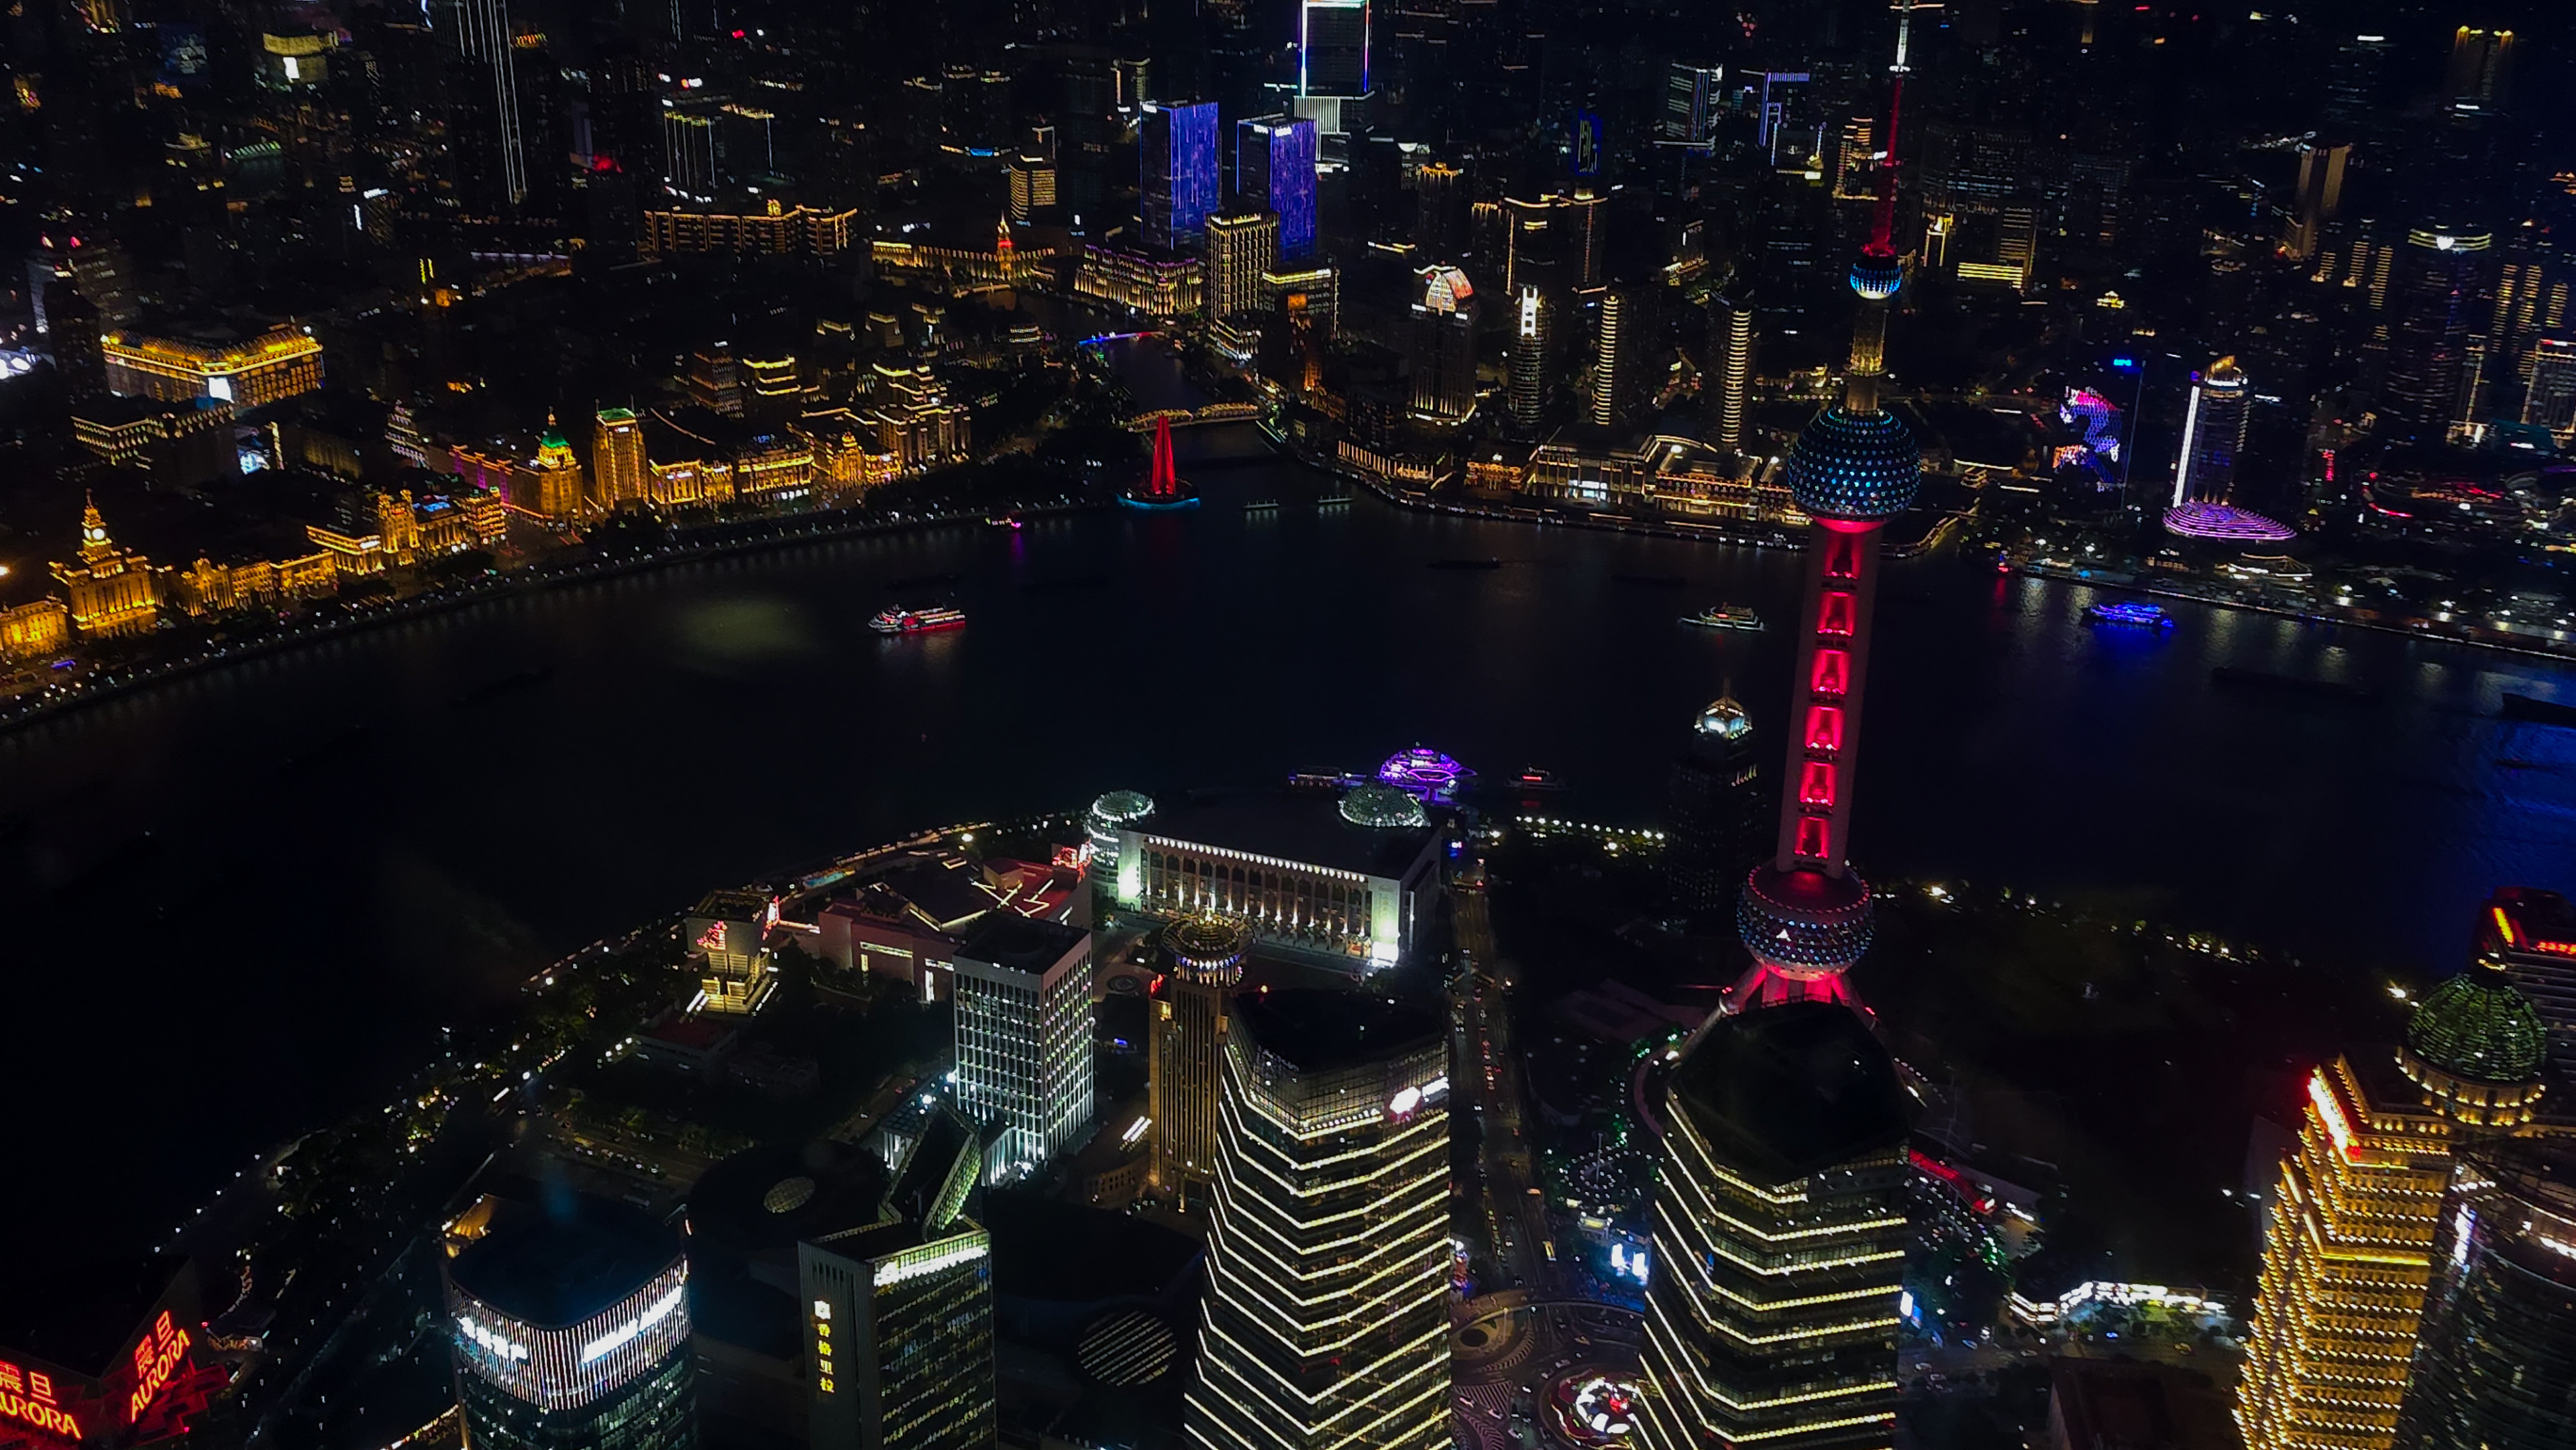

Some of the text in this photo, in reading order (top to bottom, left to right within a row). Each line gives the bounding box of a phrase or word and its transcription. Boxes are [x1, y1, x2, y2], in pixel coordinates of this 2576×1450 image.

[131, 1329, 191, 1423] AURORA
[136, 1310, 174, 1379] 震旦
[0, 1391, 82, 1440] URORA
